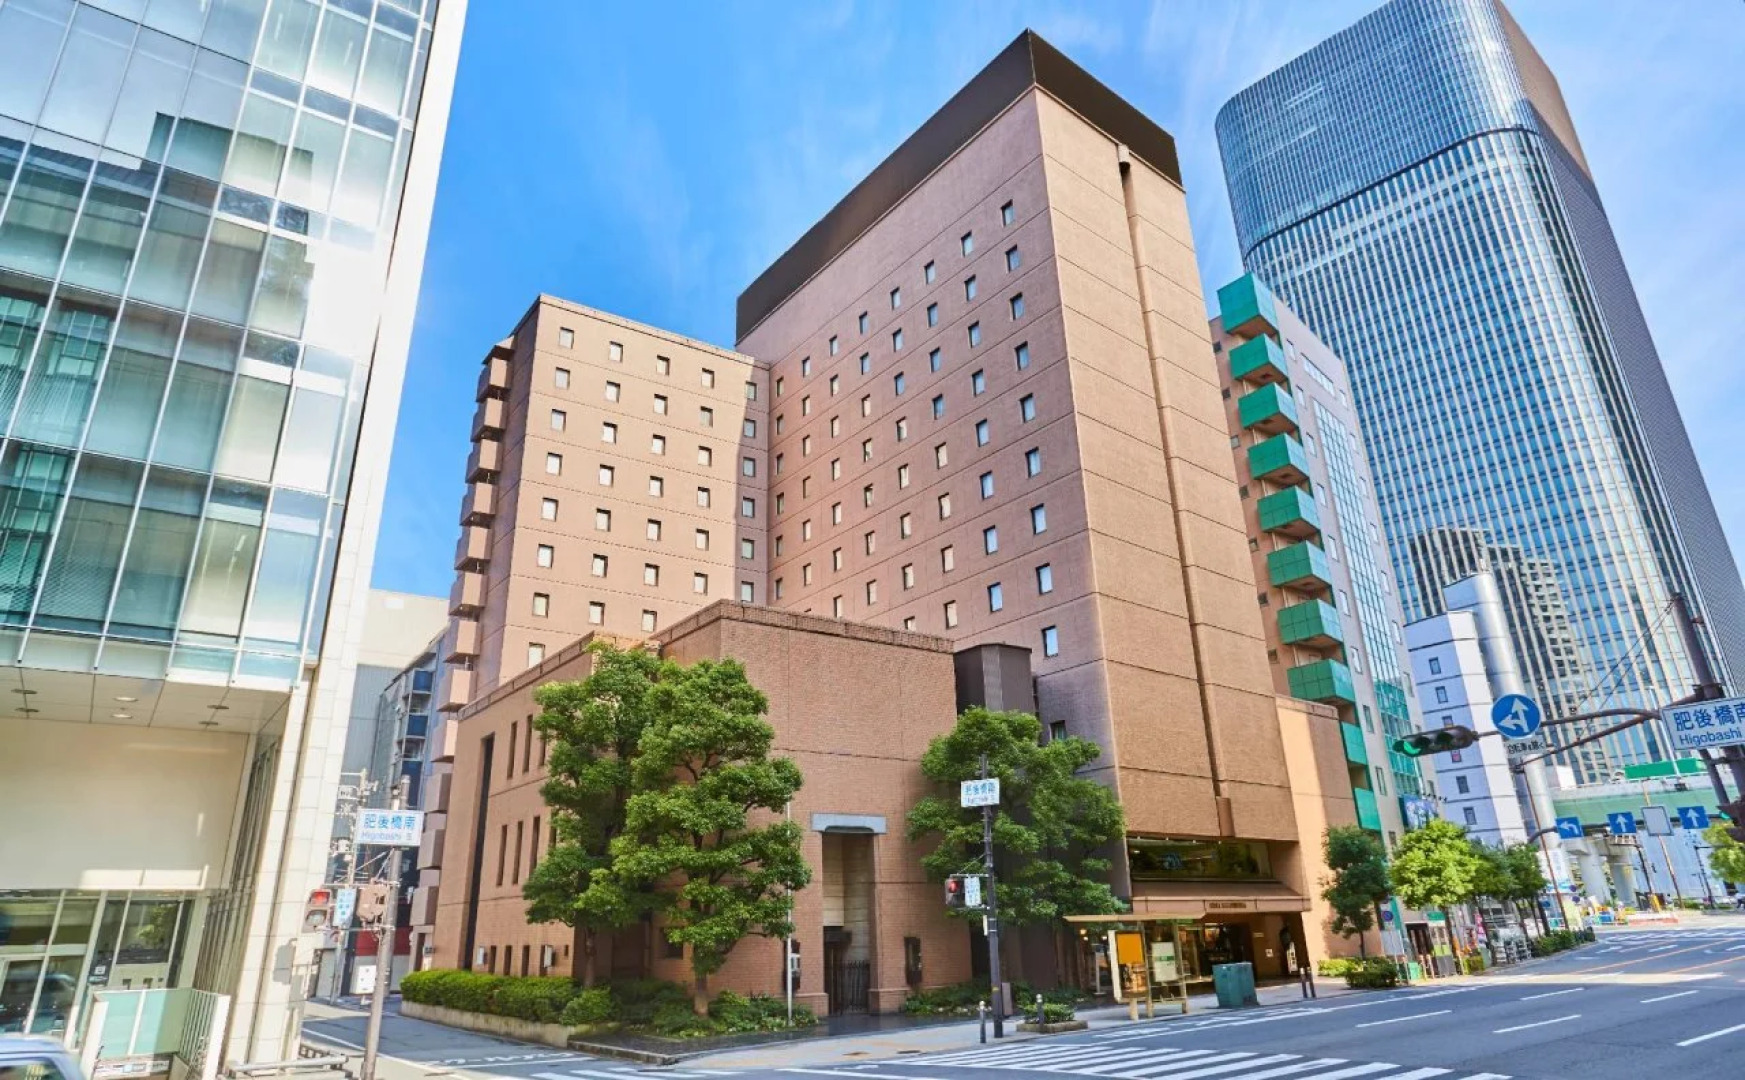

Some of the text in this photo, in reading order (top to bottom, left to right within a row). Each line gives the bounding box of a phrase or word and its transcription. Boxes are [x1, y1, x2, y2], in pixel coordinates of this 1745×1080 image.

[1680, 727, 1742, 746] Higobashi
[364, 813, 416, 829] 肥後橋南
